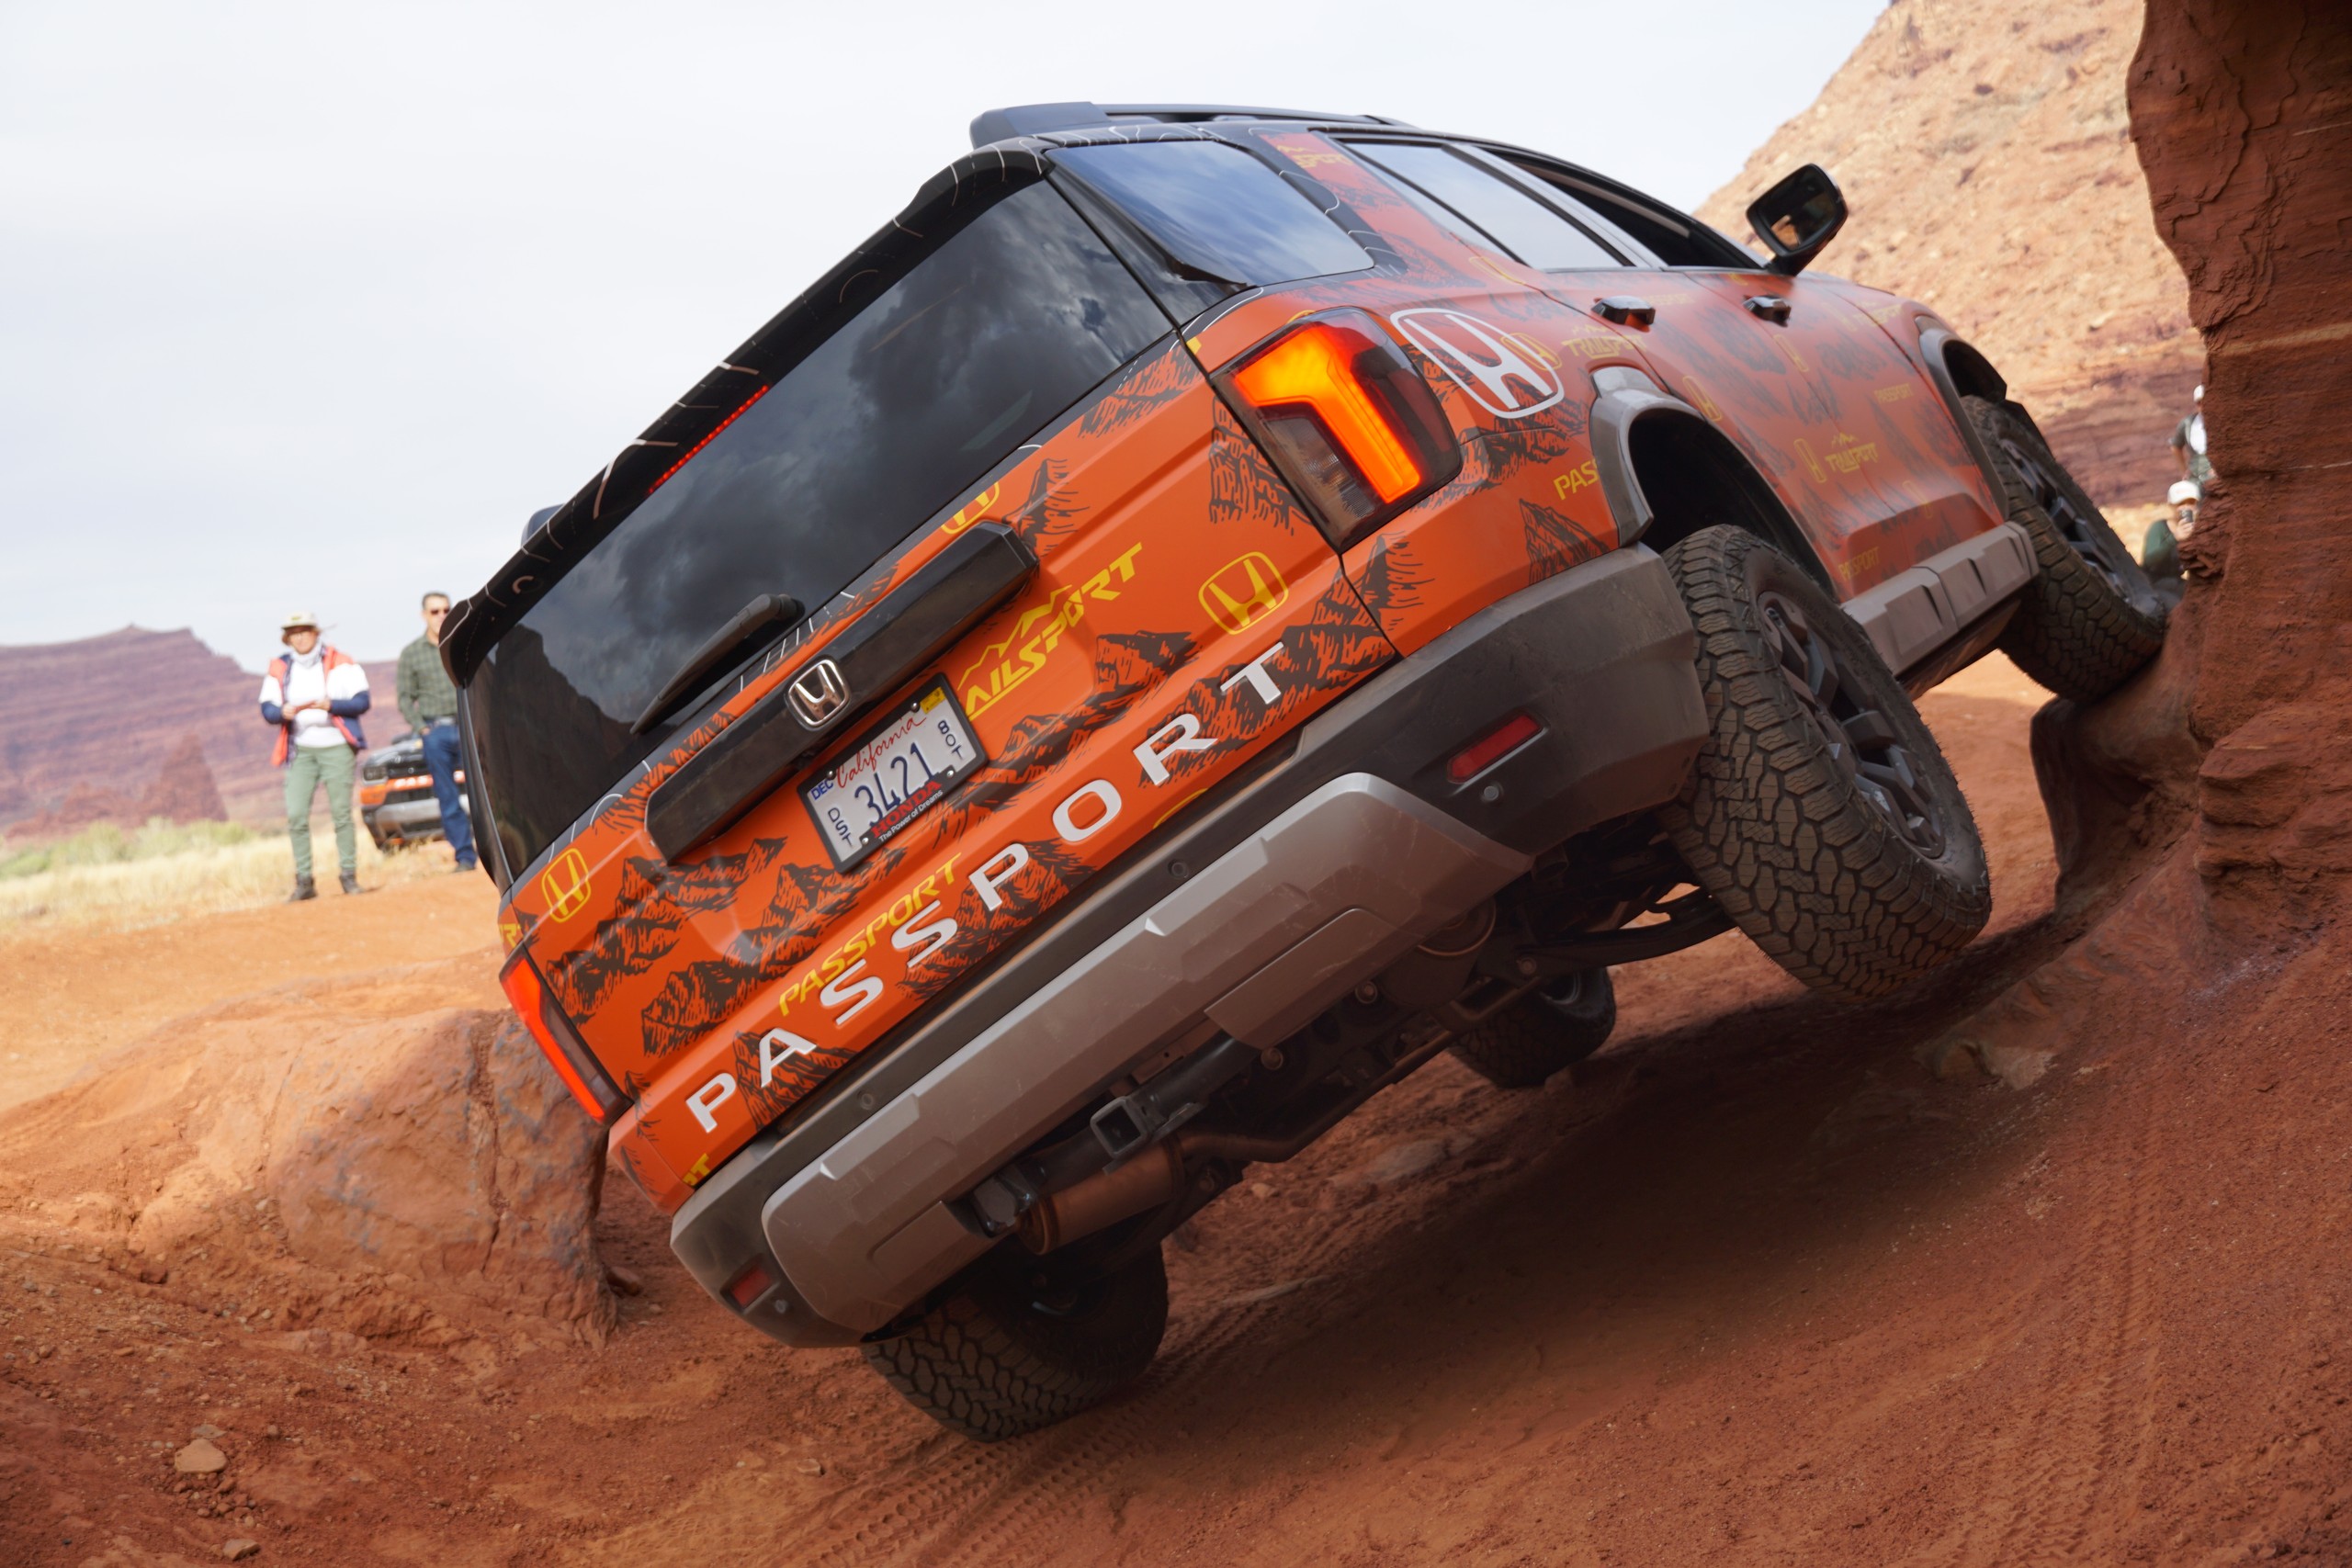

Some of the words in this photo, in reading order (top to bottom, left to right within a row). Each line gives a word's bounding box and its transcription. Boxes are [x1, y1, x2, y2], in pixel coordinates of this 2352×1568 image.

[836, 716, 927, 788] California
[854, 741, 939, 828] 3421
[810, 777, 834, 801] DEC
[871, 780, 942, 839] HONDA
[878, 829, 892, 843] The
[890, 814, 911, 836] Power
[910, 807, 920, 820] of
[918, 789, 944, 817] Dreams
[828, 807, 854, 850] DST
[685, 642, 1284, 1133] PASSPORT
[779, 852, 962, 1017] PASSPORT
